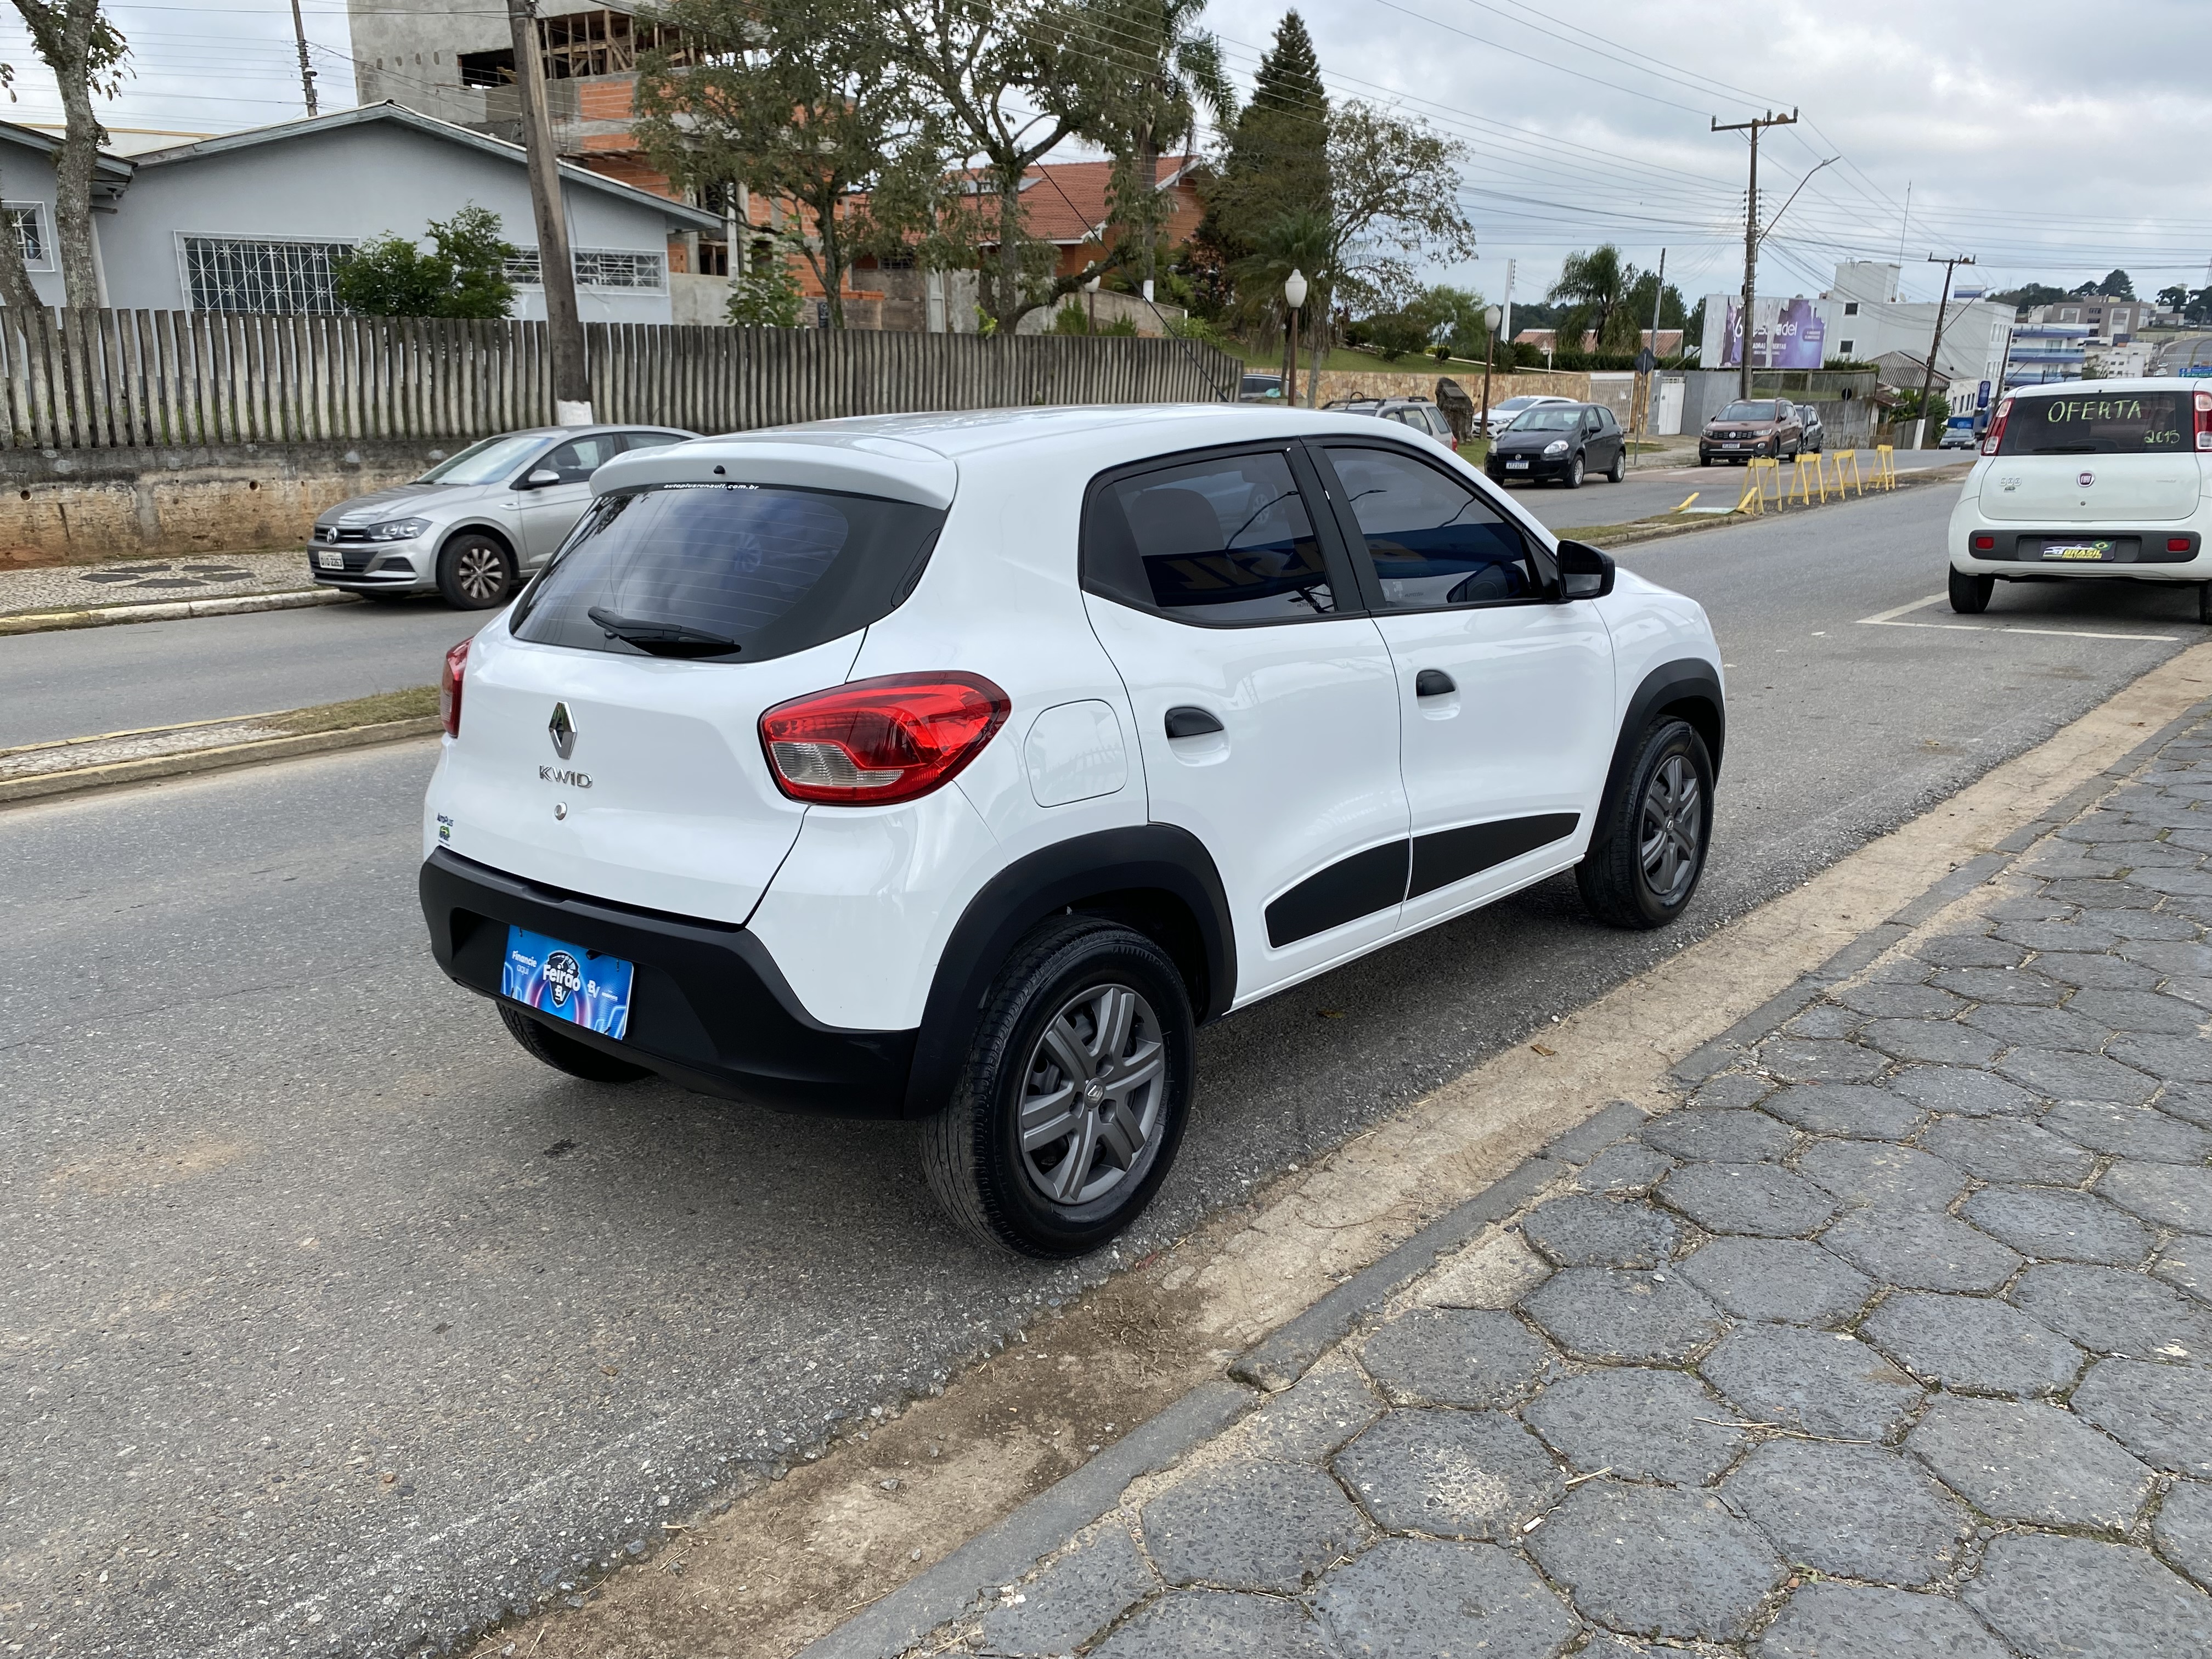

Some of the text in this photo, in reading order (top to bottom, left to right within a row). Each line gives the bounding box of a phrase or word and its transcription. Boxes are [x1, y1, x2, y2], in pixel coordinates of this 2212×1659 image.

[2047, 399, 2141, 422] OFERTA
[2144, 430, 2181, 444] 2015
[539, 765, 593, 788] KWID
[512, 950, 537, 968] Financie
[517, 964, 530, 975] aqui
[543, 964, 580, 991] Feirão
